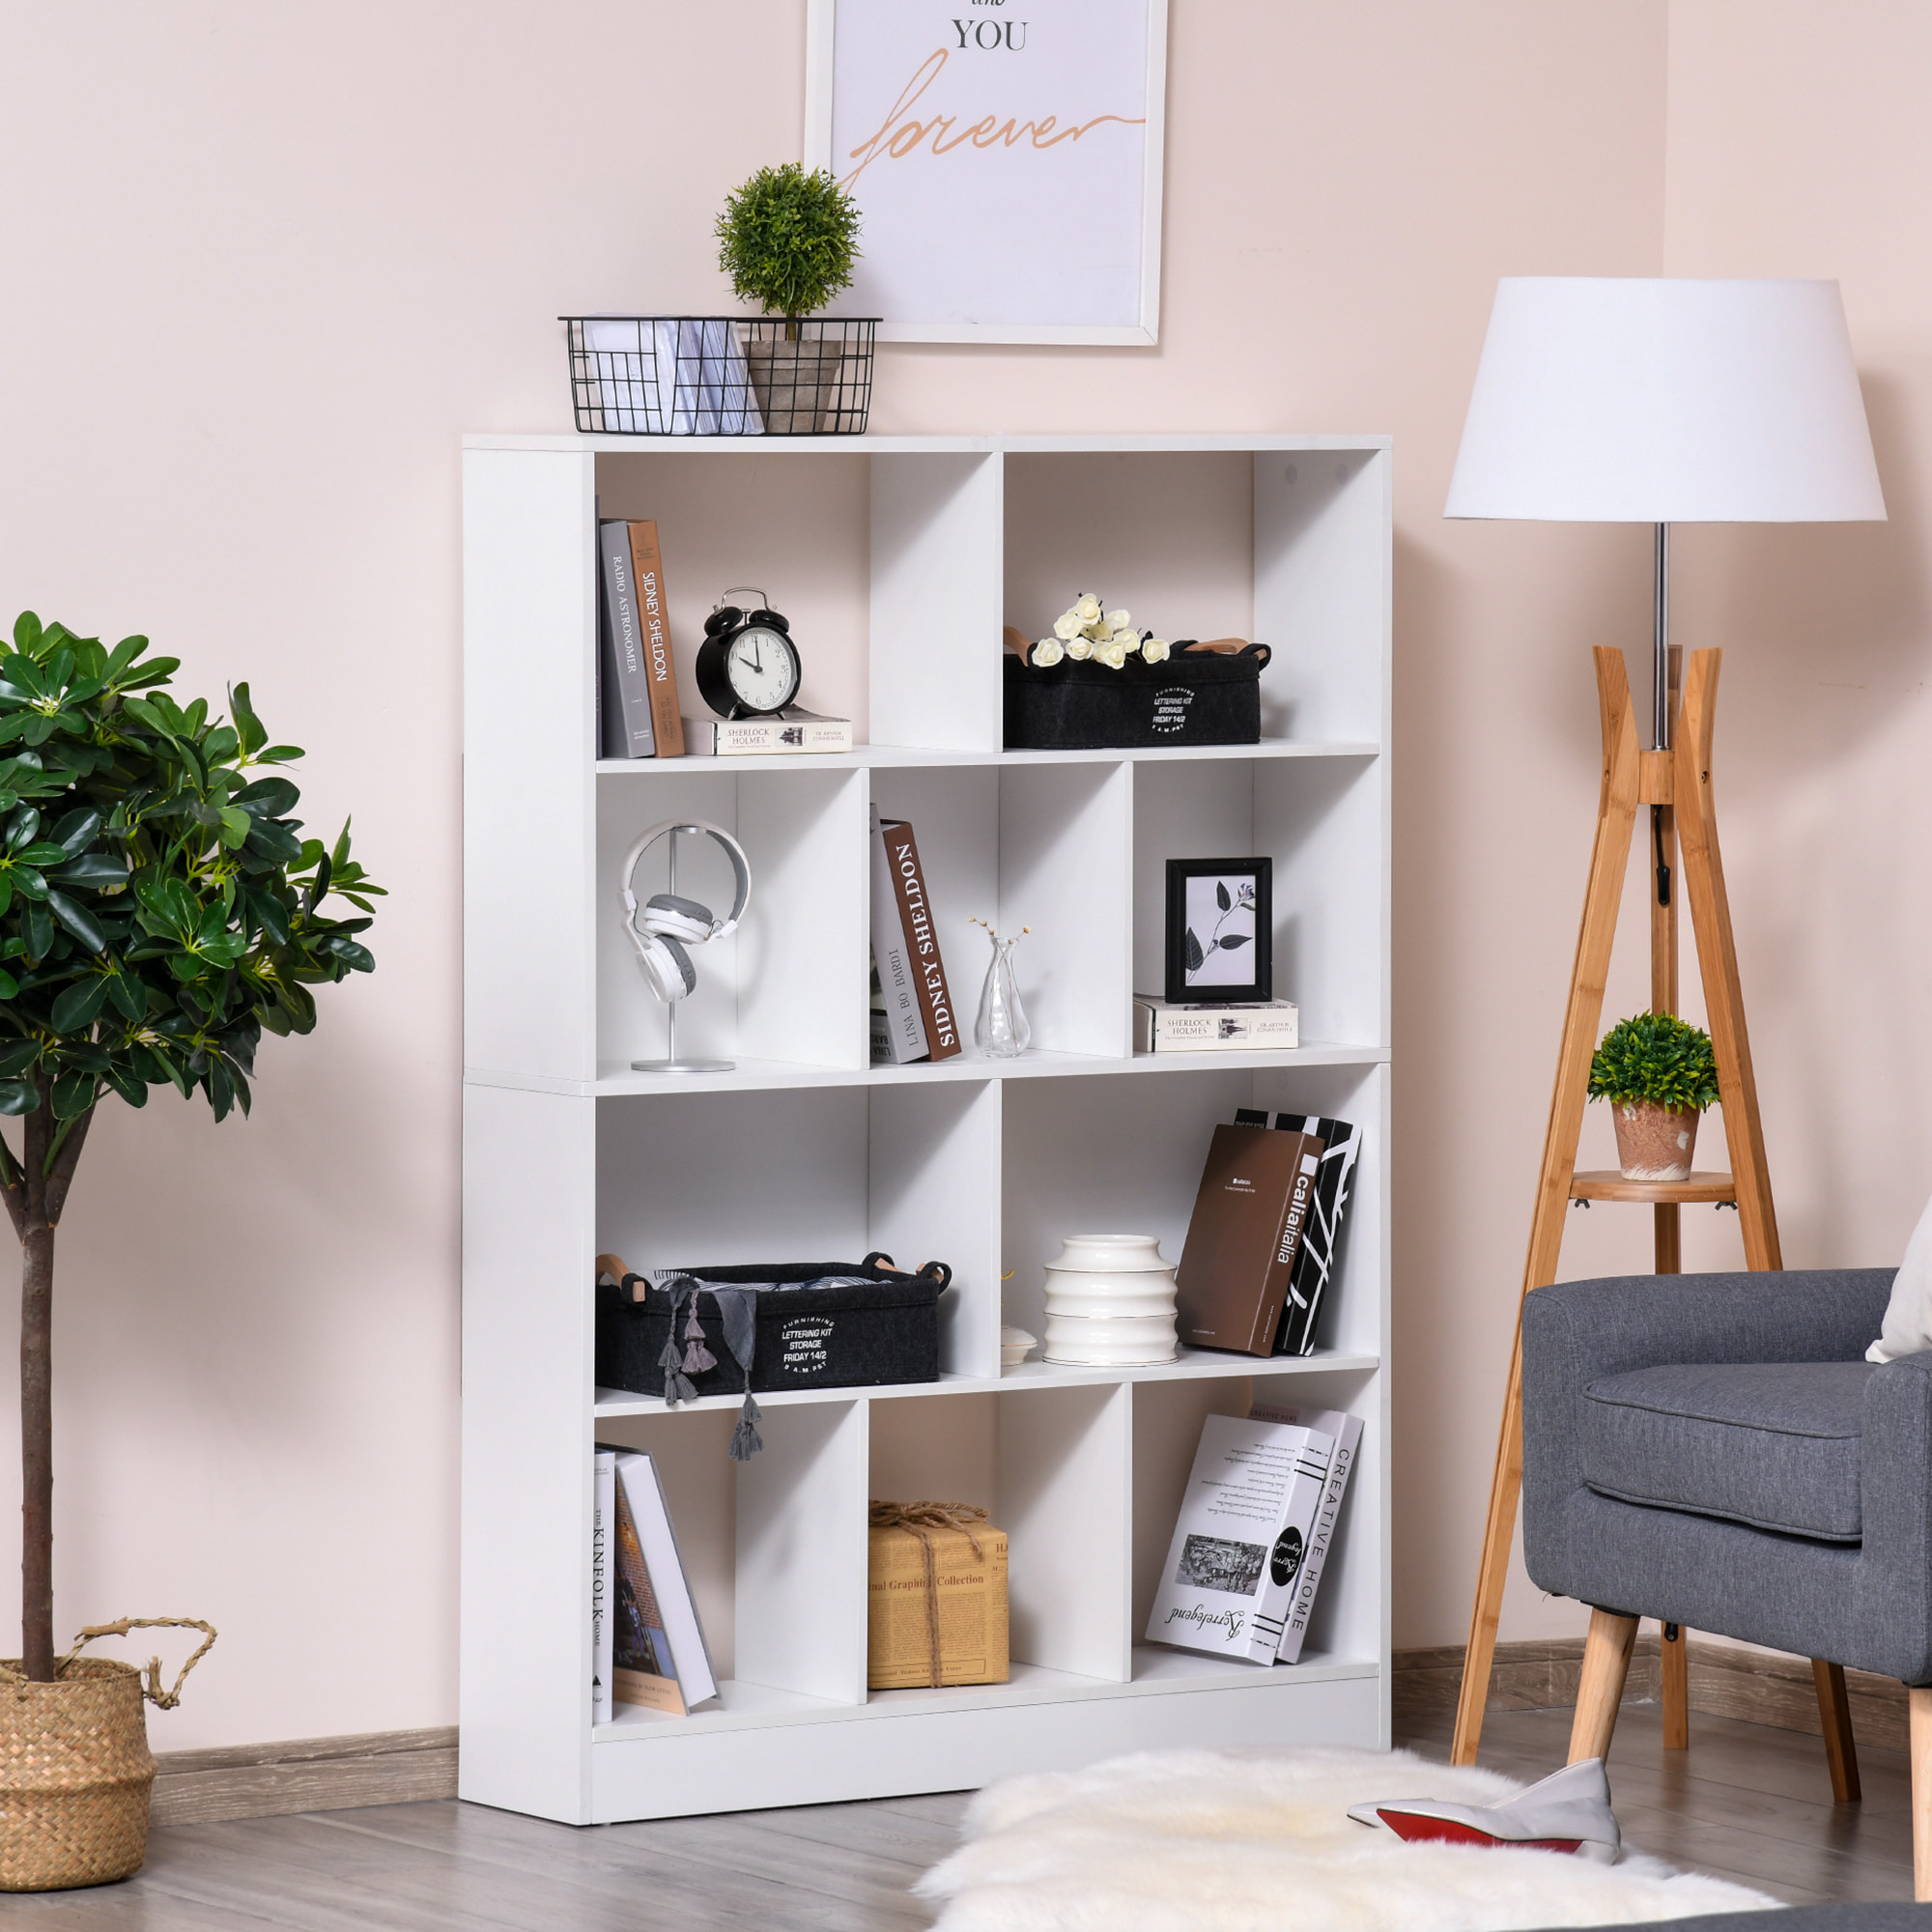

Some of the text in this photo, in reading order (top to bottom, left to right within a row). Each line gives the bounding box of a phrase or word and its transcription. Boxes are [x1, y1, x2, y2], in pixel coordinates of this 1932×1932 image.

[952, 19, 1029, 50] YOU
[839, 48, 1146, 196] forever
[613, 555, 637, 673] RADIO ASTRONOMER
[642, 571, 660, 616] SIDNEY
[649, 618, 668, 682] SHELDON
[743, 691, 749, 700] 7
[732, 736, 765, 745] HOLMES
[895, 842, 955, 1047] SIDNEY SHELDON
[889, 948, 919, 1047] LINA BO BARDI
[1277, 1177, 1309, 1264] caliaitalia
[781, 1328, 820, 1340] LETTERING
[783, 1350, 827, 1362] FRIDAY 14/2
[789, 1340, 822, 1350] STORAGE
[1293, 1448, 1350, 1631] CREATIVE HOME
[592, 1527, 604, 1621] KINFOLK
[937, 1575, 983, 1587] Collection
